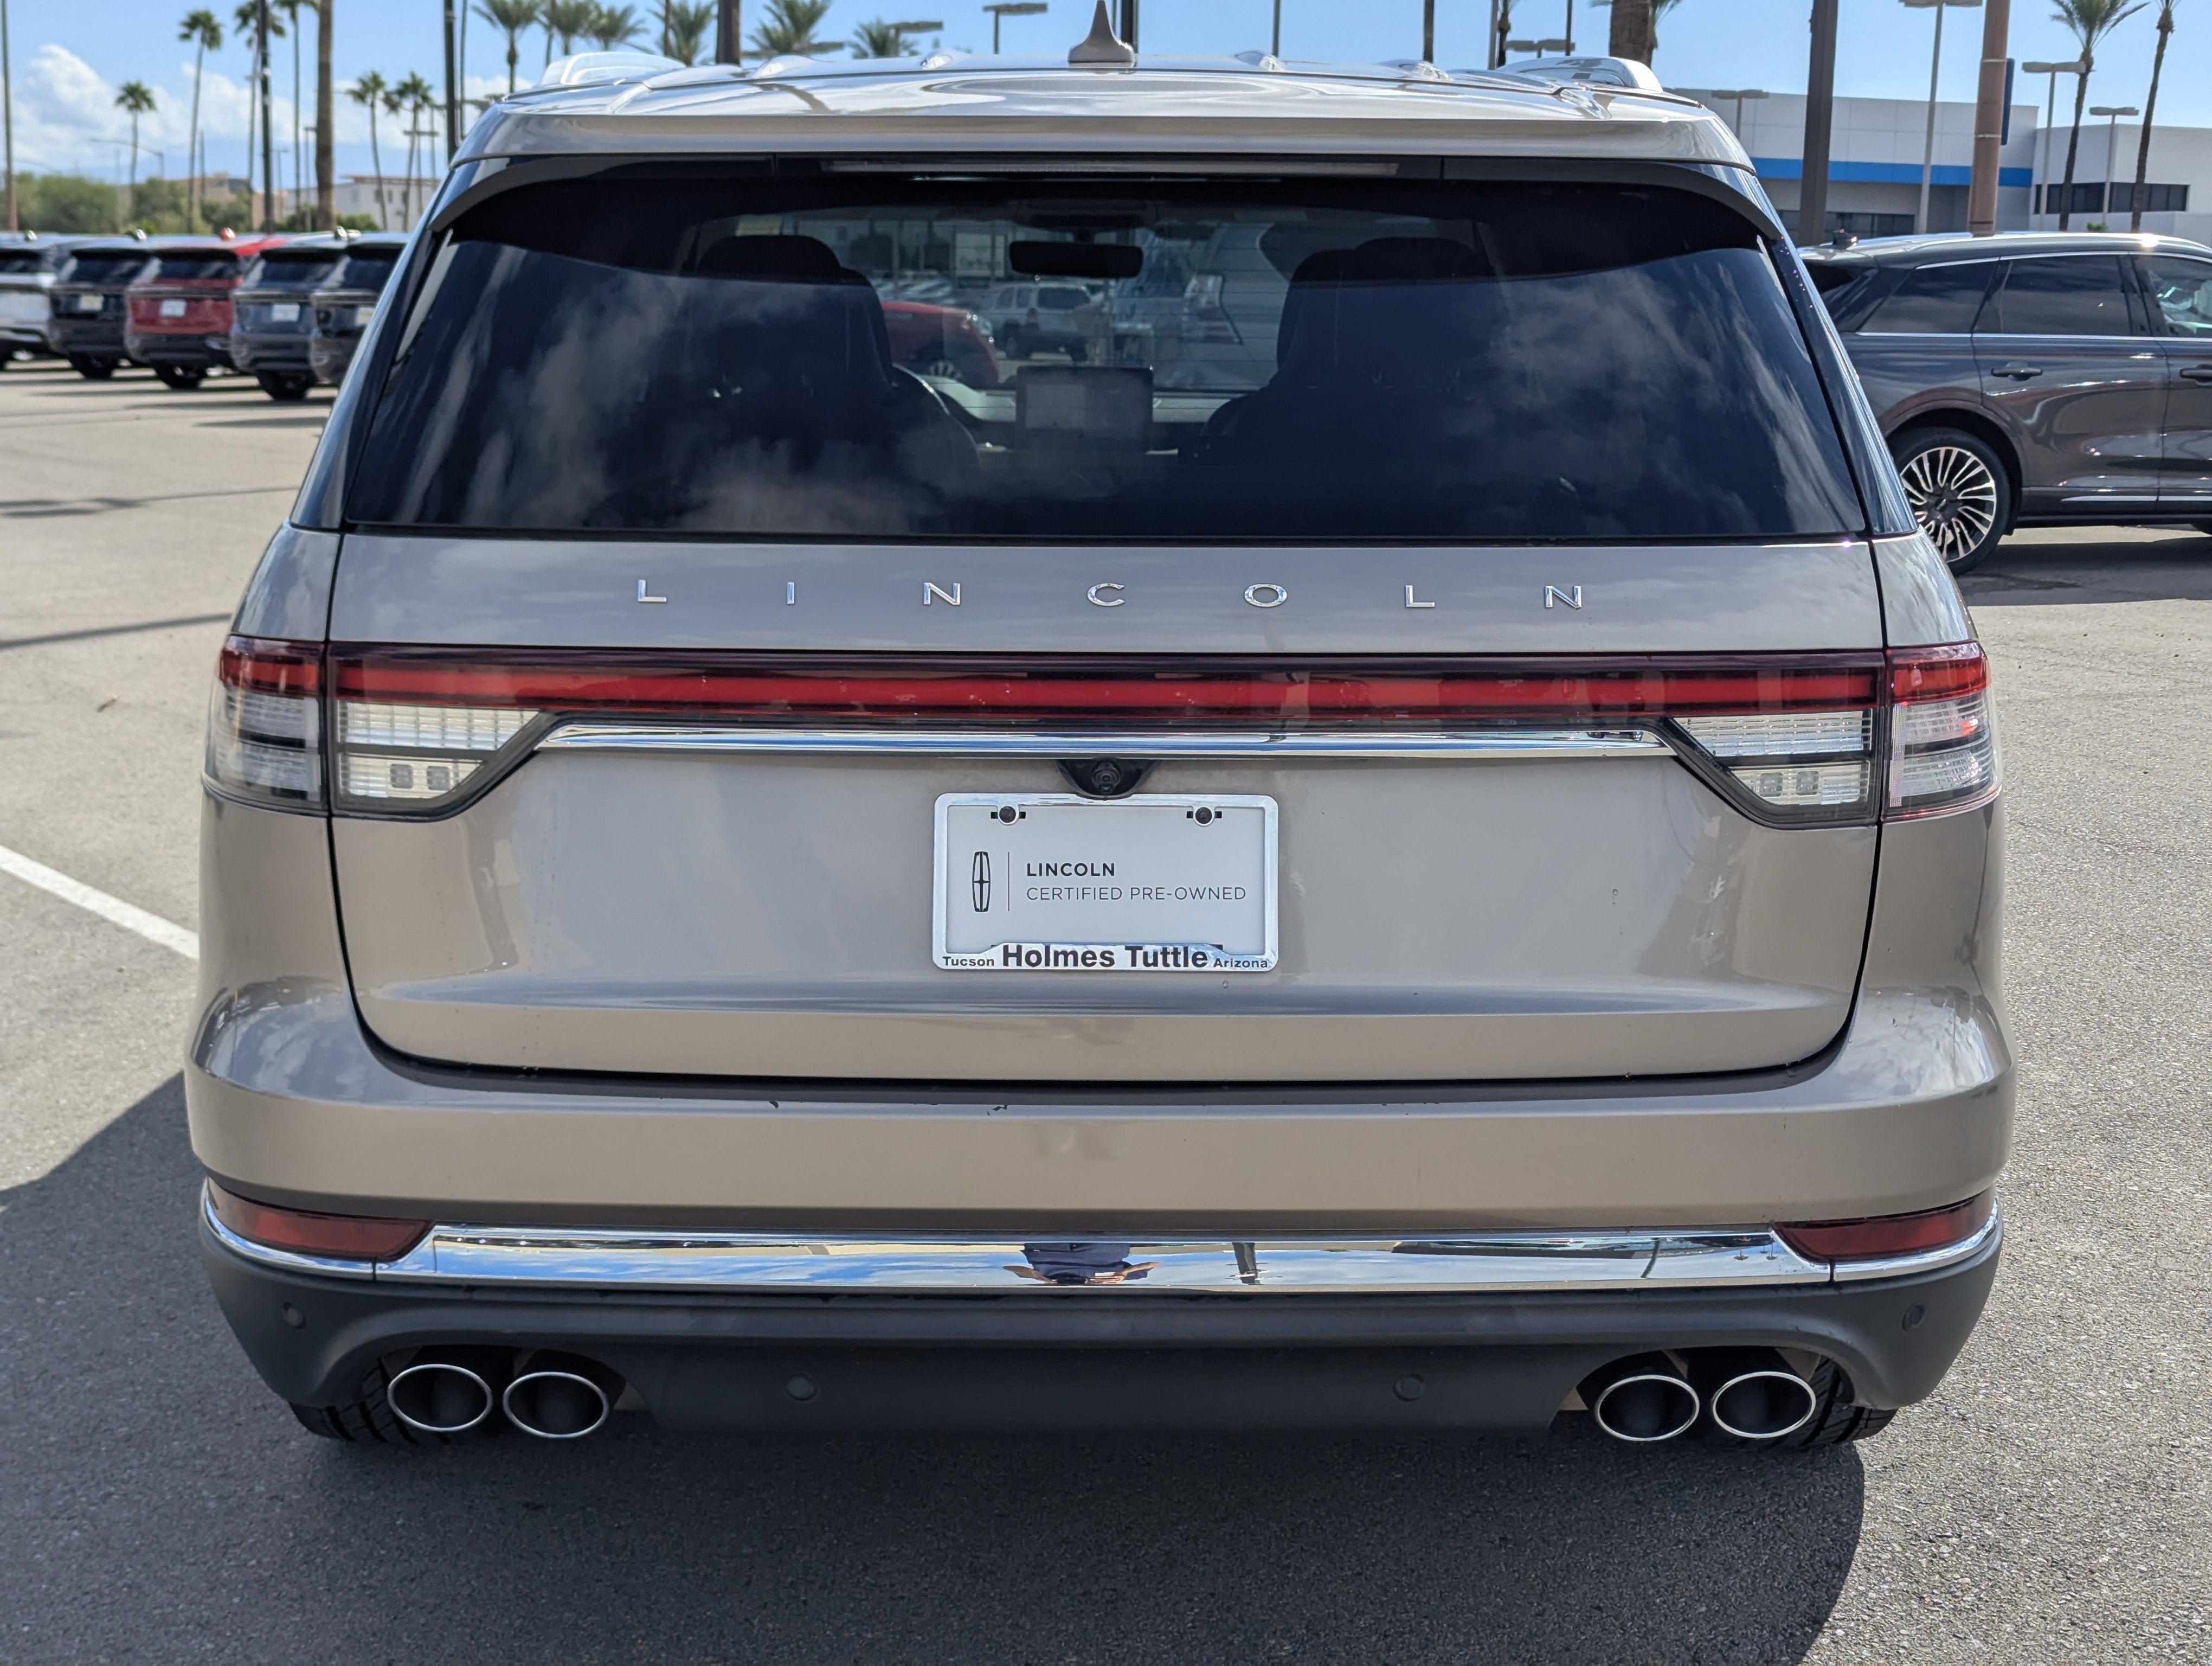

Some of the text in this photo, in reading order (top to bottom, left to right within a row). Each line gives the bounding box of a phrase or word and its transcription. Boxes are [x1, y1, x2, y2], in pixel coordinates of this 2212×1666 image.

[637, 579, 1582, 609] LINCOLN
[1026, 863, 1115, 877] LINCOLN
[1026, 887, 1246, 901] CERTIFIED PRE-OWNED
[943, 945, 1268, 969] Tucson Holmes Tuttle Arizona
